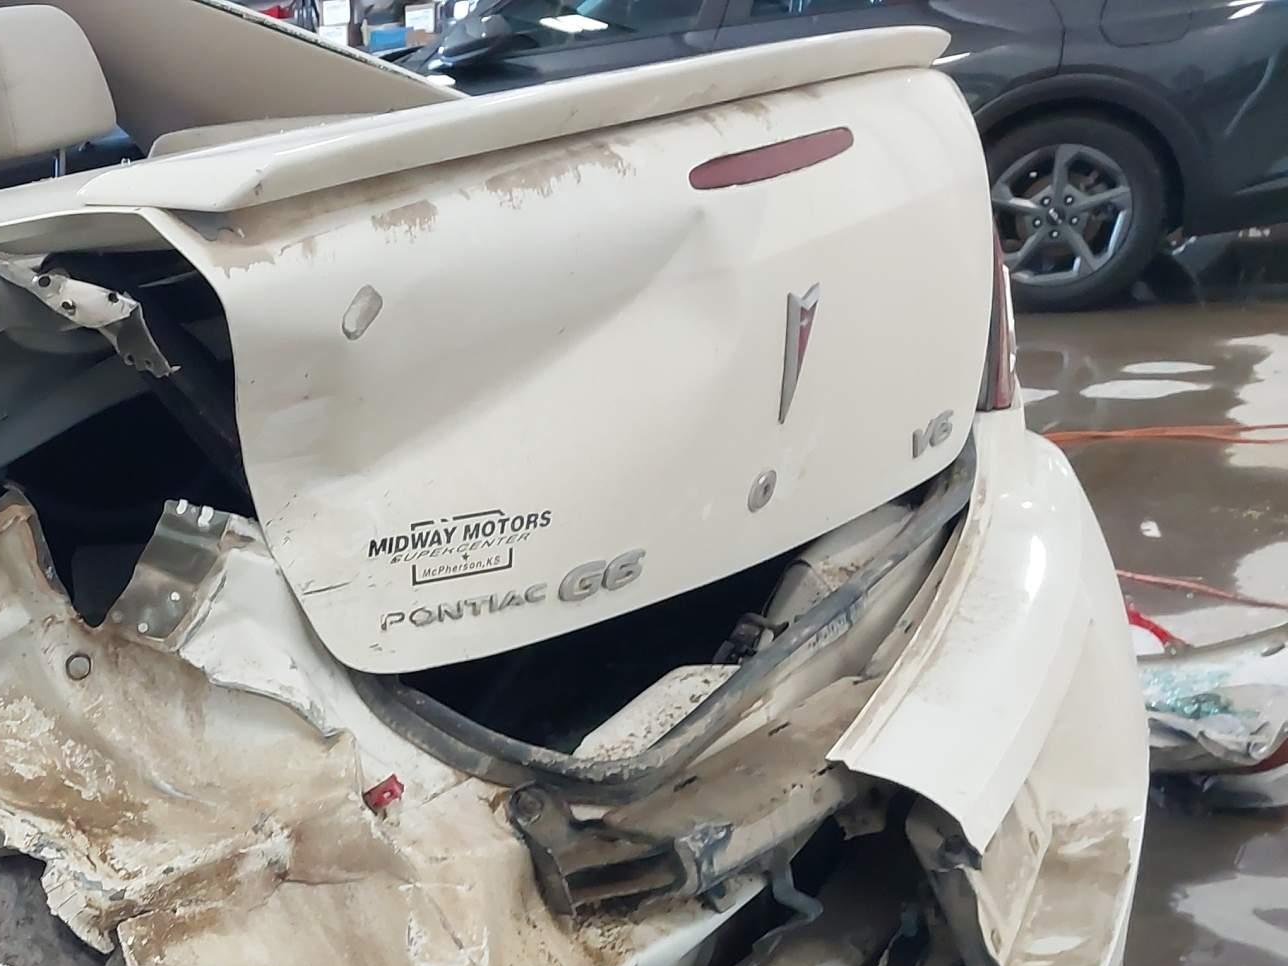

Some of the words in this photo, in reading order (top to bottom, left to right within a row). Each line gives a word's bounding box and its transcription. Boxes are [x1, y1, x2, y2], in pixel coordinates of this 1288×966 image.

[912, 409, 954, 458] V6
[368, 526, 457, 557] MIDWAY
[462, 510, 552, 542] MOTORS
[390, 532, 531, 564] SUPERCENTER
[380, 583, 547, 631] PONTIAC
[558, 548, 647, 602] G6
